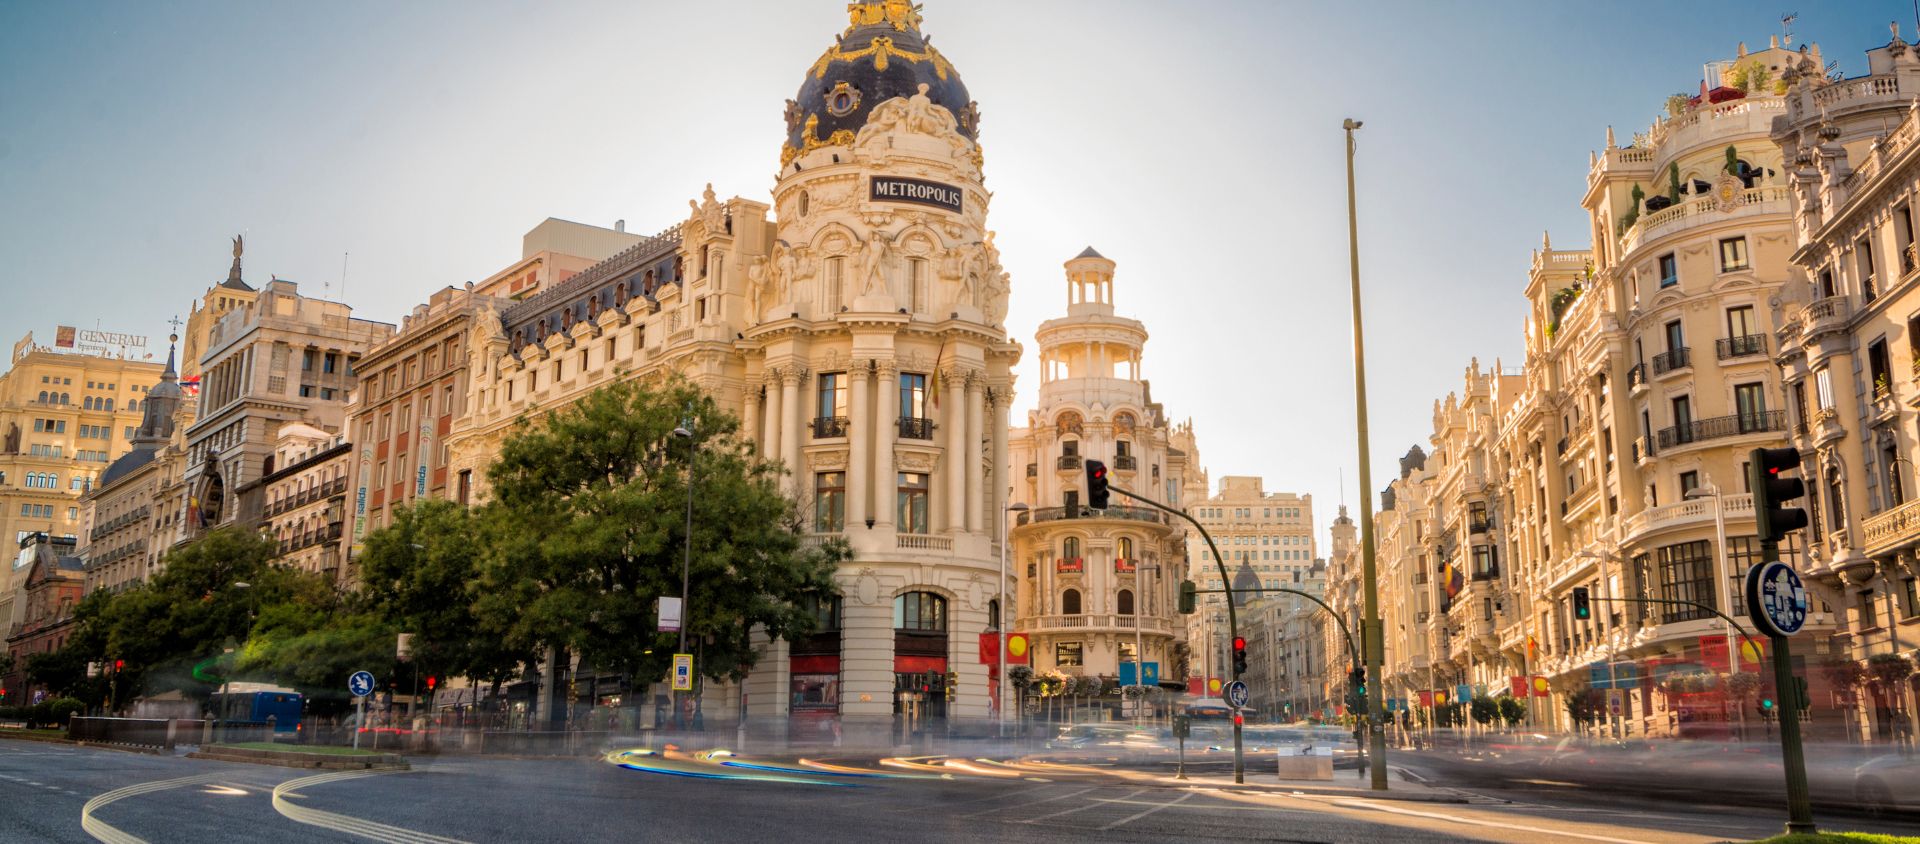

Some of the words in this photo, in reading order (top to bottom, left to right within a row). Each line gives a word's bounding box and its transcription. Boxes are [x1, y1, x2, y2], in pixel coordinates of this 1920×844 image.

[876, 182, 960, 205] METROPOLIS
[79, 330, 148, 346] GENERALI
[416, 466, 426, 495] salida
[358, 487, 366, 514] salida
